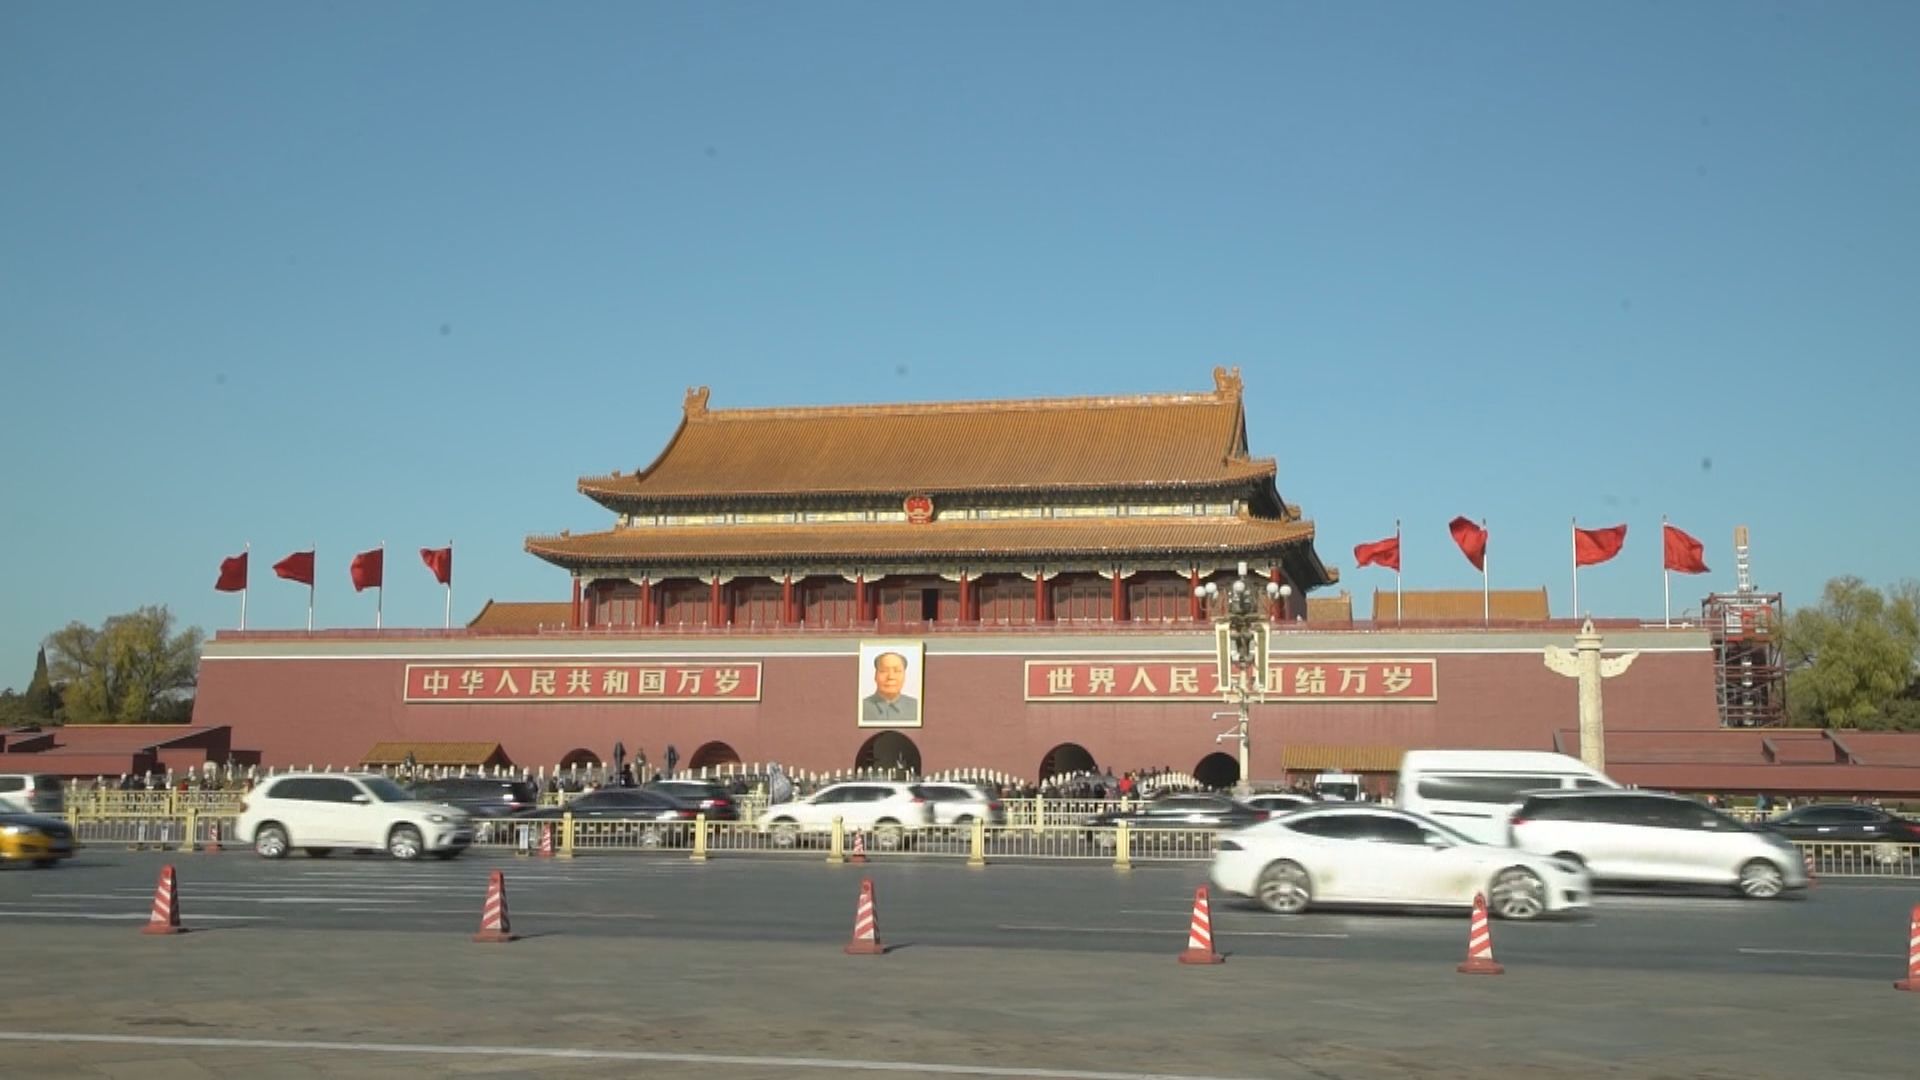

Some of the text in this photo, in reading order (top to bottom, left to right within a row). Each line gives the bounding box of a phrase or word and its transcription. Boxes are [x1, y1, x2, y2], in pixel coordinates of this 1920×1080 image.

[422, 669, 741, 695] 中华人民共和国万岁
